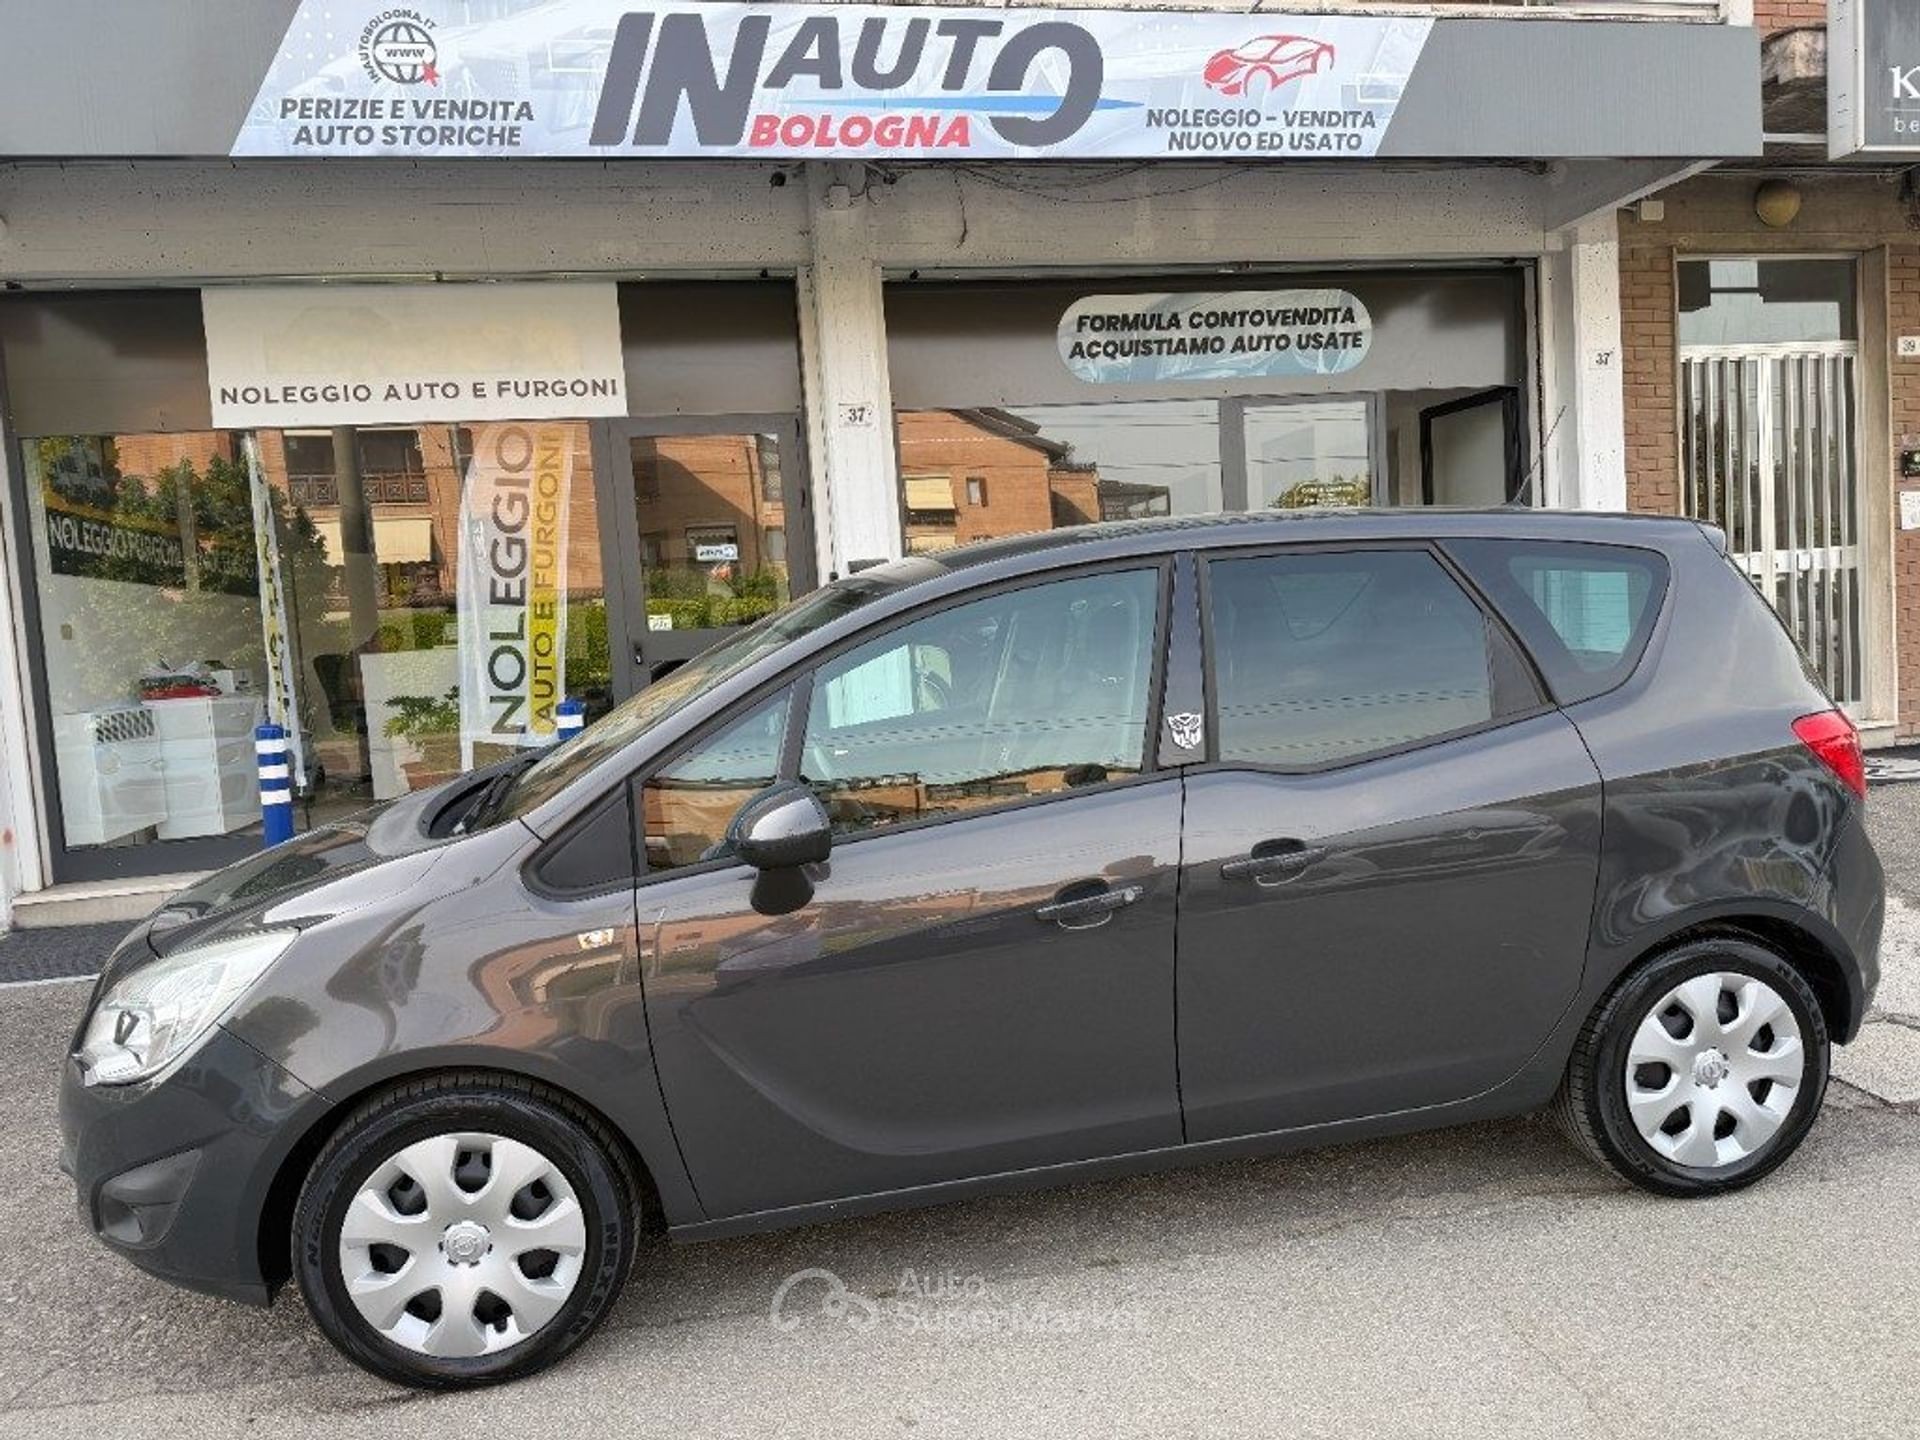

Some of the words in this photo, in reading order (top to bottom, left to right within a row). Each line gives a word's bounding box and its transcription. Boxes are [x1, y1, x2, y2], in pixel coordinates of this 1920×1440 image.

[279, 97, 384, 119] PERIZIE
[389, 99, 405, 119] E
[412, 99, 535, 121] VENDITA
[1146, 108, 1261, 129] NOLEGGIO
[1283, 109, 1377, 129] VENDITA
[292, 125, 375, 146] AUTO
[381, 125, 522, 147] STORICHE
[749, 114, 972, 148] BOLOGNA
[1168, 131, 1252, 151] NUOVO
[1256, 131, 1284, 151] ED
[1288, 132, 1363, 151] USATO
[1076, 311, 1182, 333] FORMULA
[1188, 307, 1356, 329] CONTOVENDITA
[1068, 336, 1225, 360] ACQUISTIAMO
[1230, 334, 1292, 354] AUTO
[1295, 331, 1363, 350] USATE
[1903, 339, 1916, 352] 39
[1595, 352, 1610, 365] 37
[220, 383, 373, 405] NOLEGGIO
[384, 380, 460, 402] AUTO
[472, 381, 488, 398] E
[497, 378, 618, 398] FURGONI
[848, 407, 866, 422] 37
[534, 433, 562, 588] FURGONI
[49, 512, 124, 560] NOLEGGIO
[488, 426, 534, 734] NOLEGGIO
[534, 600, 554, 620] E
[534, 631, 558, 729] AUTO
